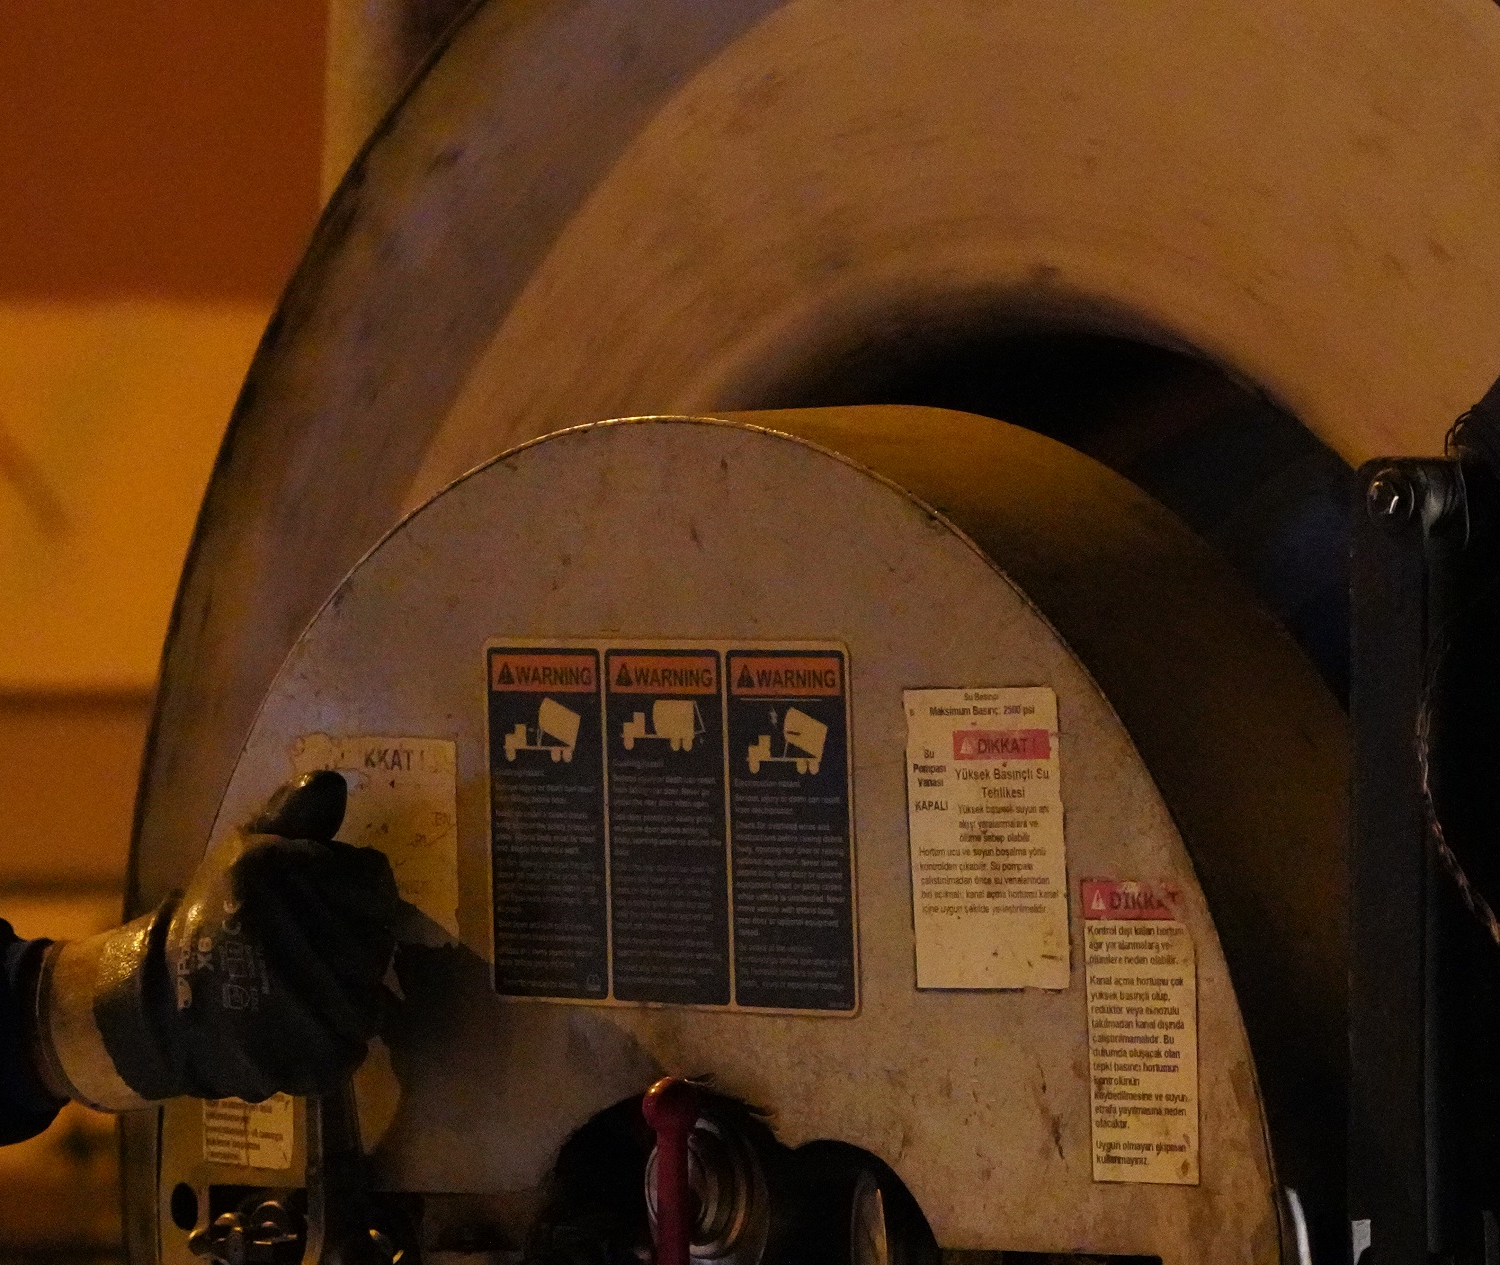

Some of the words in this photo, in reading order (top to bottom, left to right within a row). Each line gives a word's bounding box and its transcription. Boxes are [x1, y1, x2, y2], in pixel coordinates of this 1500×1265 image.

[516, 665, 592, 689] WARNING
[634, 667, 714, 690] WARNING
[756, 668, 837, 690] WARNING
[929, 706, 971, 716] Maksimum
[1023, 705, 1035, 717] psi
[924, 749, 935, 759] Su
[954, 768, 991, 781] Yüksek
[1036, 768, 1049, 781] Su
[982, 787, 1025, 799] Tehlikesi
[915, 801, 949, 812] KAPALI
[990, 861, 1000, 871] Su
[1090, 975, 1112, 985] Kanal
[1126, 1006, 1143, 1017] veya
[1163, 1034, 1175, 1044] Bu
[1164, 1049, 1180, 1059] olan
[1155, 1093, 1164, 1101] ve
[1164, 1107, 1187, 1116] neden
[1096, 1140, 1121, 1152] Uygun
[1122, 1141, 1154, 1153] olmayan
